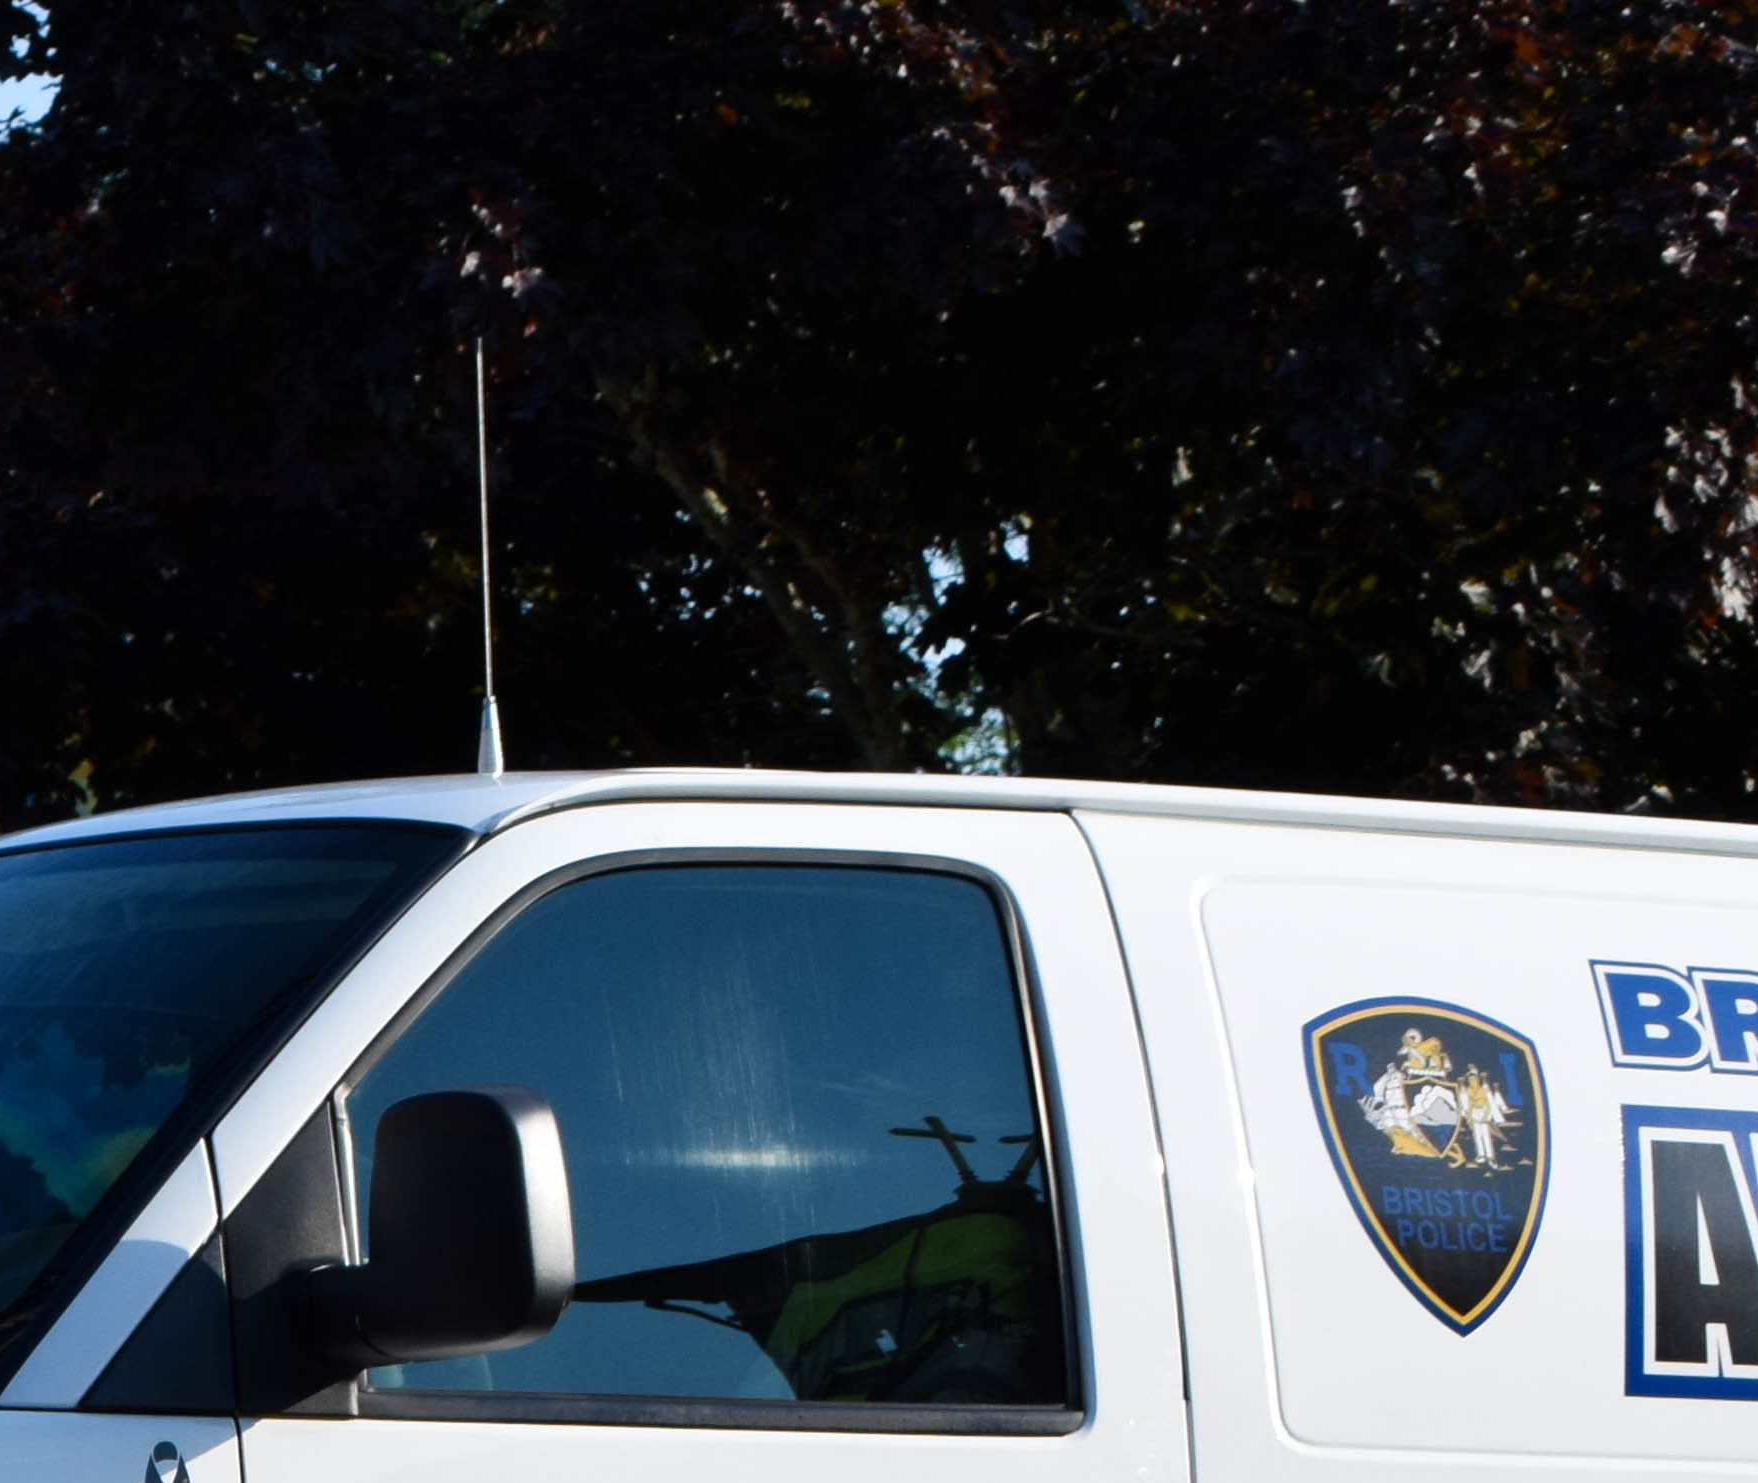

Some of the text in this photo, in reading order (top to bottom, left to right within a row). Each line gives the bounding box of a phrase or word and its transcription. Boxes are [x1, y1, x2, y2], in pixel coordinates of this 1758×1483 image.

[1327, 1042, 1524, 1106] R I
[1380, 1185, 1513, 1222] BRISTOL
[1396, 1219, 1507, 1253] POLICE
